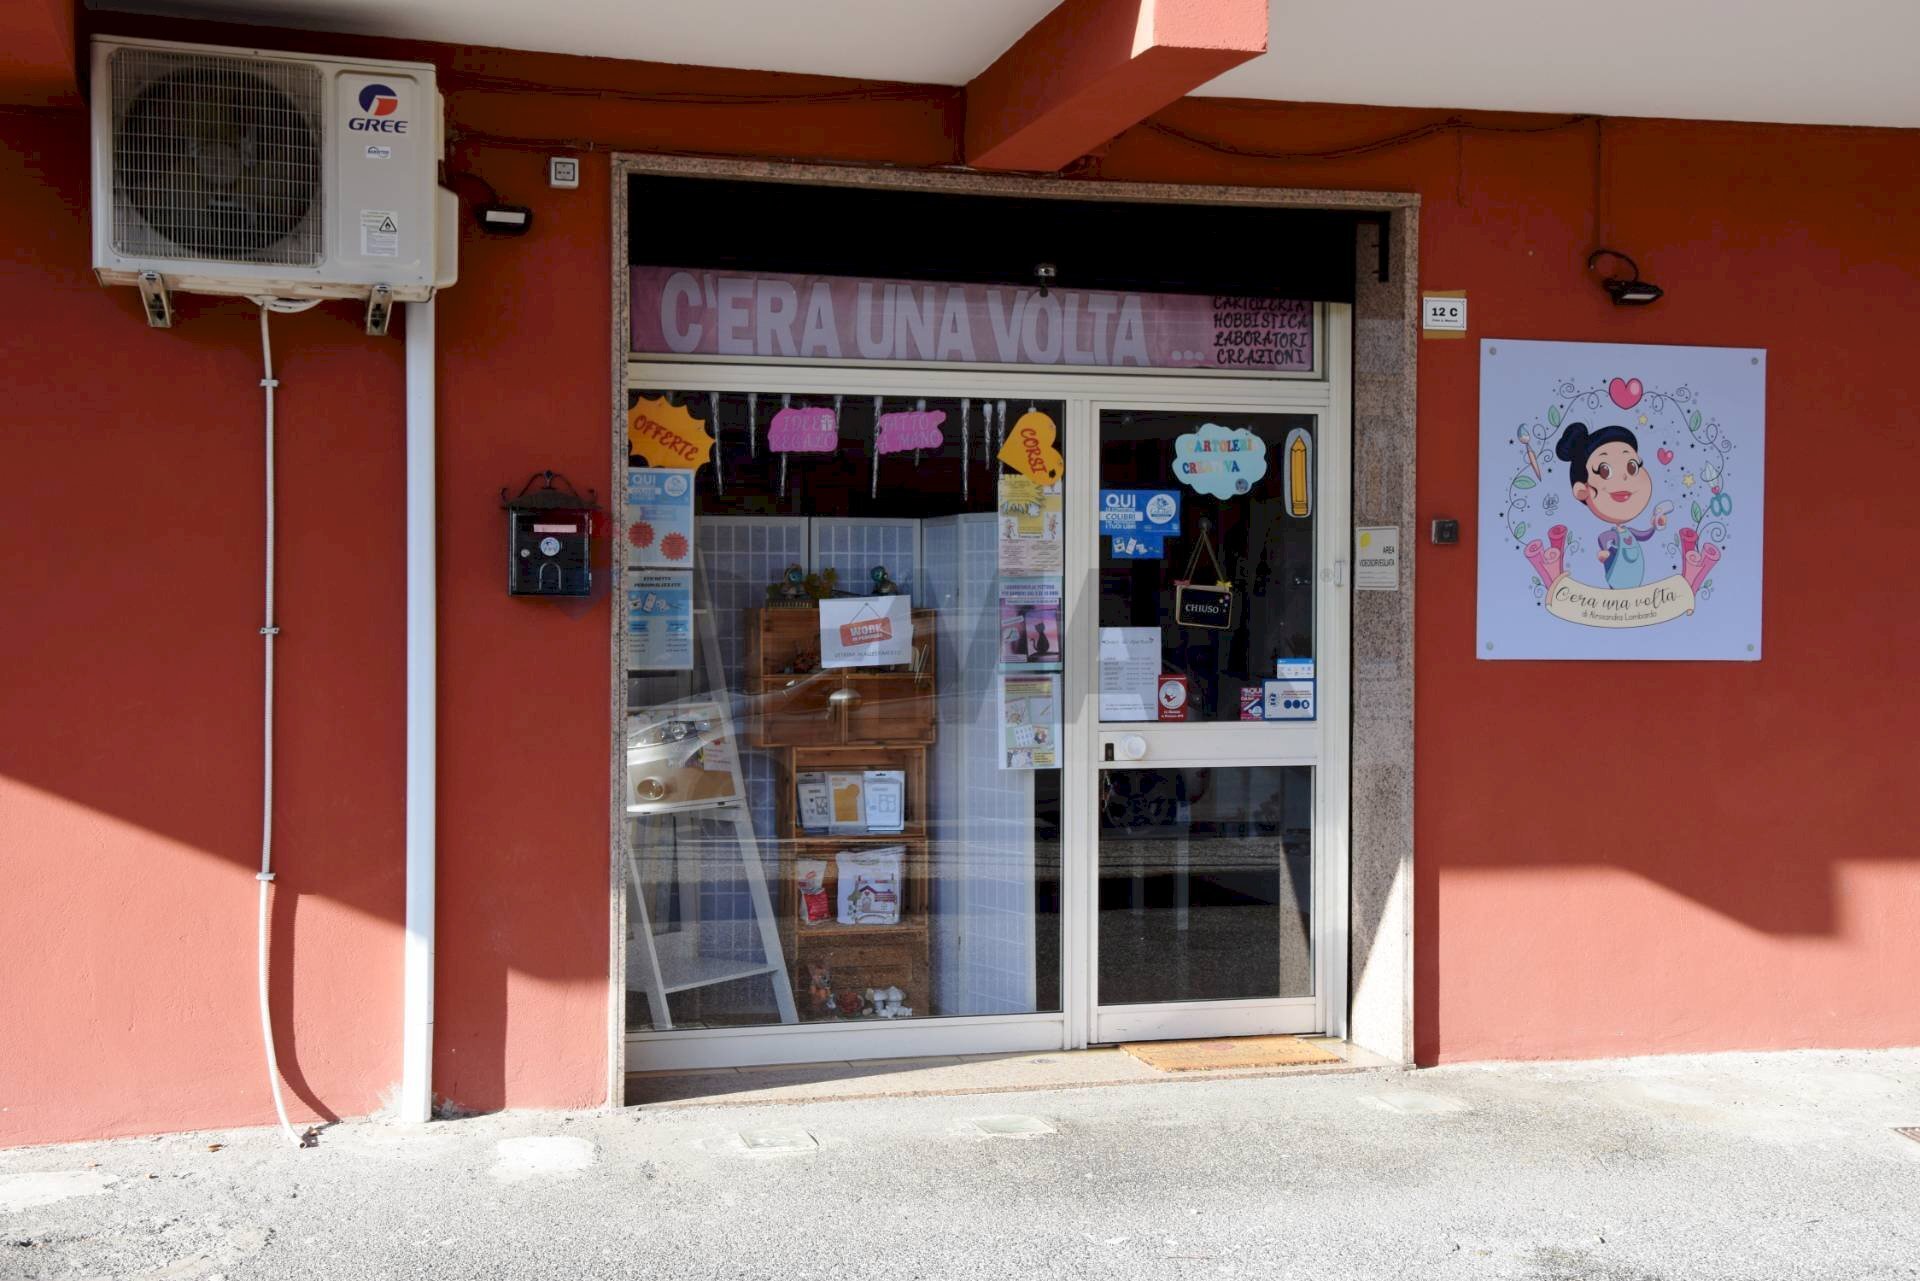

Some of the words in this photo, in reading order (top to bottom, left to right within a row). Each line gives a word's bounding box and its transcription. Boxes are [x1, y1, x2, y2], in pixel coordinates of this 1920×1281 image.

[348, 117, 409, 134] GREE
[661, 271, 844, 357] C'ERA
[857, 282, 976, 362] UNA
[986, 288, 1150, 366] VOLTA
[1432, 307, 1446, 316] 12
[1450, 307, 1458, 317] C
[1214, 313, 1308, 329] HOBBISTICA
[1214, 331, 1309, 348] LABORATORI
[1217, 349, 1306, 364] CREAZIONI
[634, 415, 699, 461] OFFERTE
[1021, 428, 1047, 474] CORSI
[1106, 494, 1136, 507] QUI
[1383, 546, 1395, 554] AREA
[1185, 604, 1220, 614] CHIUSO
[1602, 598, 1630, 612] una
[1589, 612, 1623, 622] Alessandra
[1624, 609, 1658, 622] Lombardo
[850, 623, 884, 637] WORK
